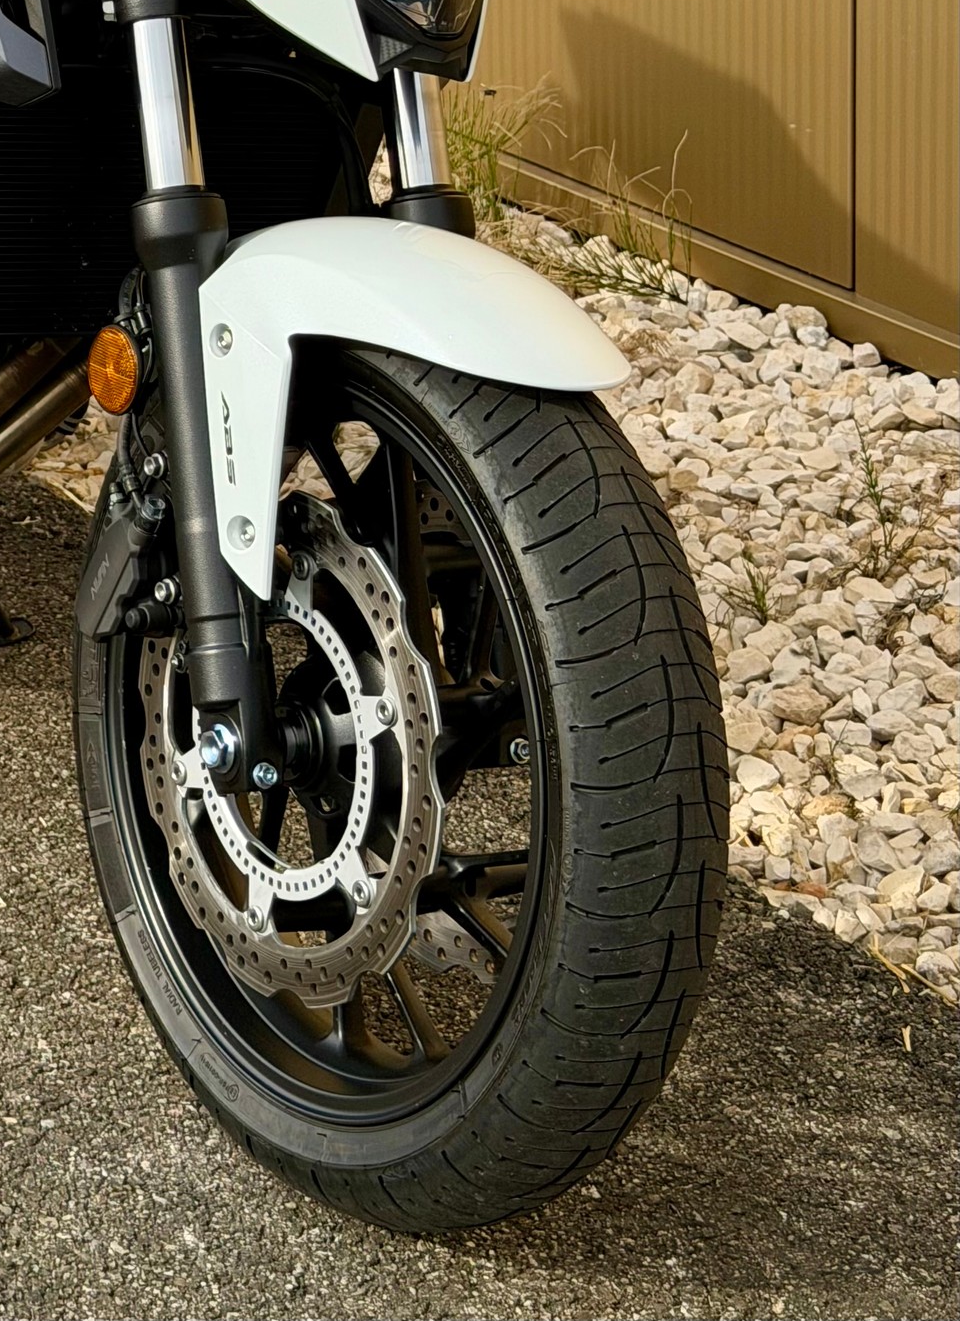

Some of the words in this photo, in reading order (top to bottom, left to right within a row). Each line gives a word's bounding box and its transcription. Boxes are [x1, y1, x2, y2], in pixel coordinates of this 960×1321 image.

[220, 390, 237, 487] ABS
[136, 928, 164, 982] TUBELESS
[161, 979, 183, 1017] RADIAL
